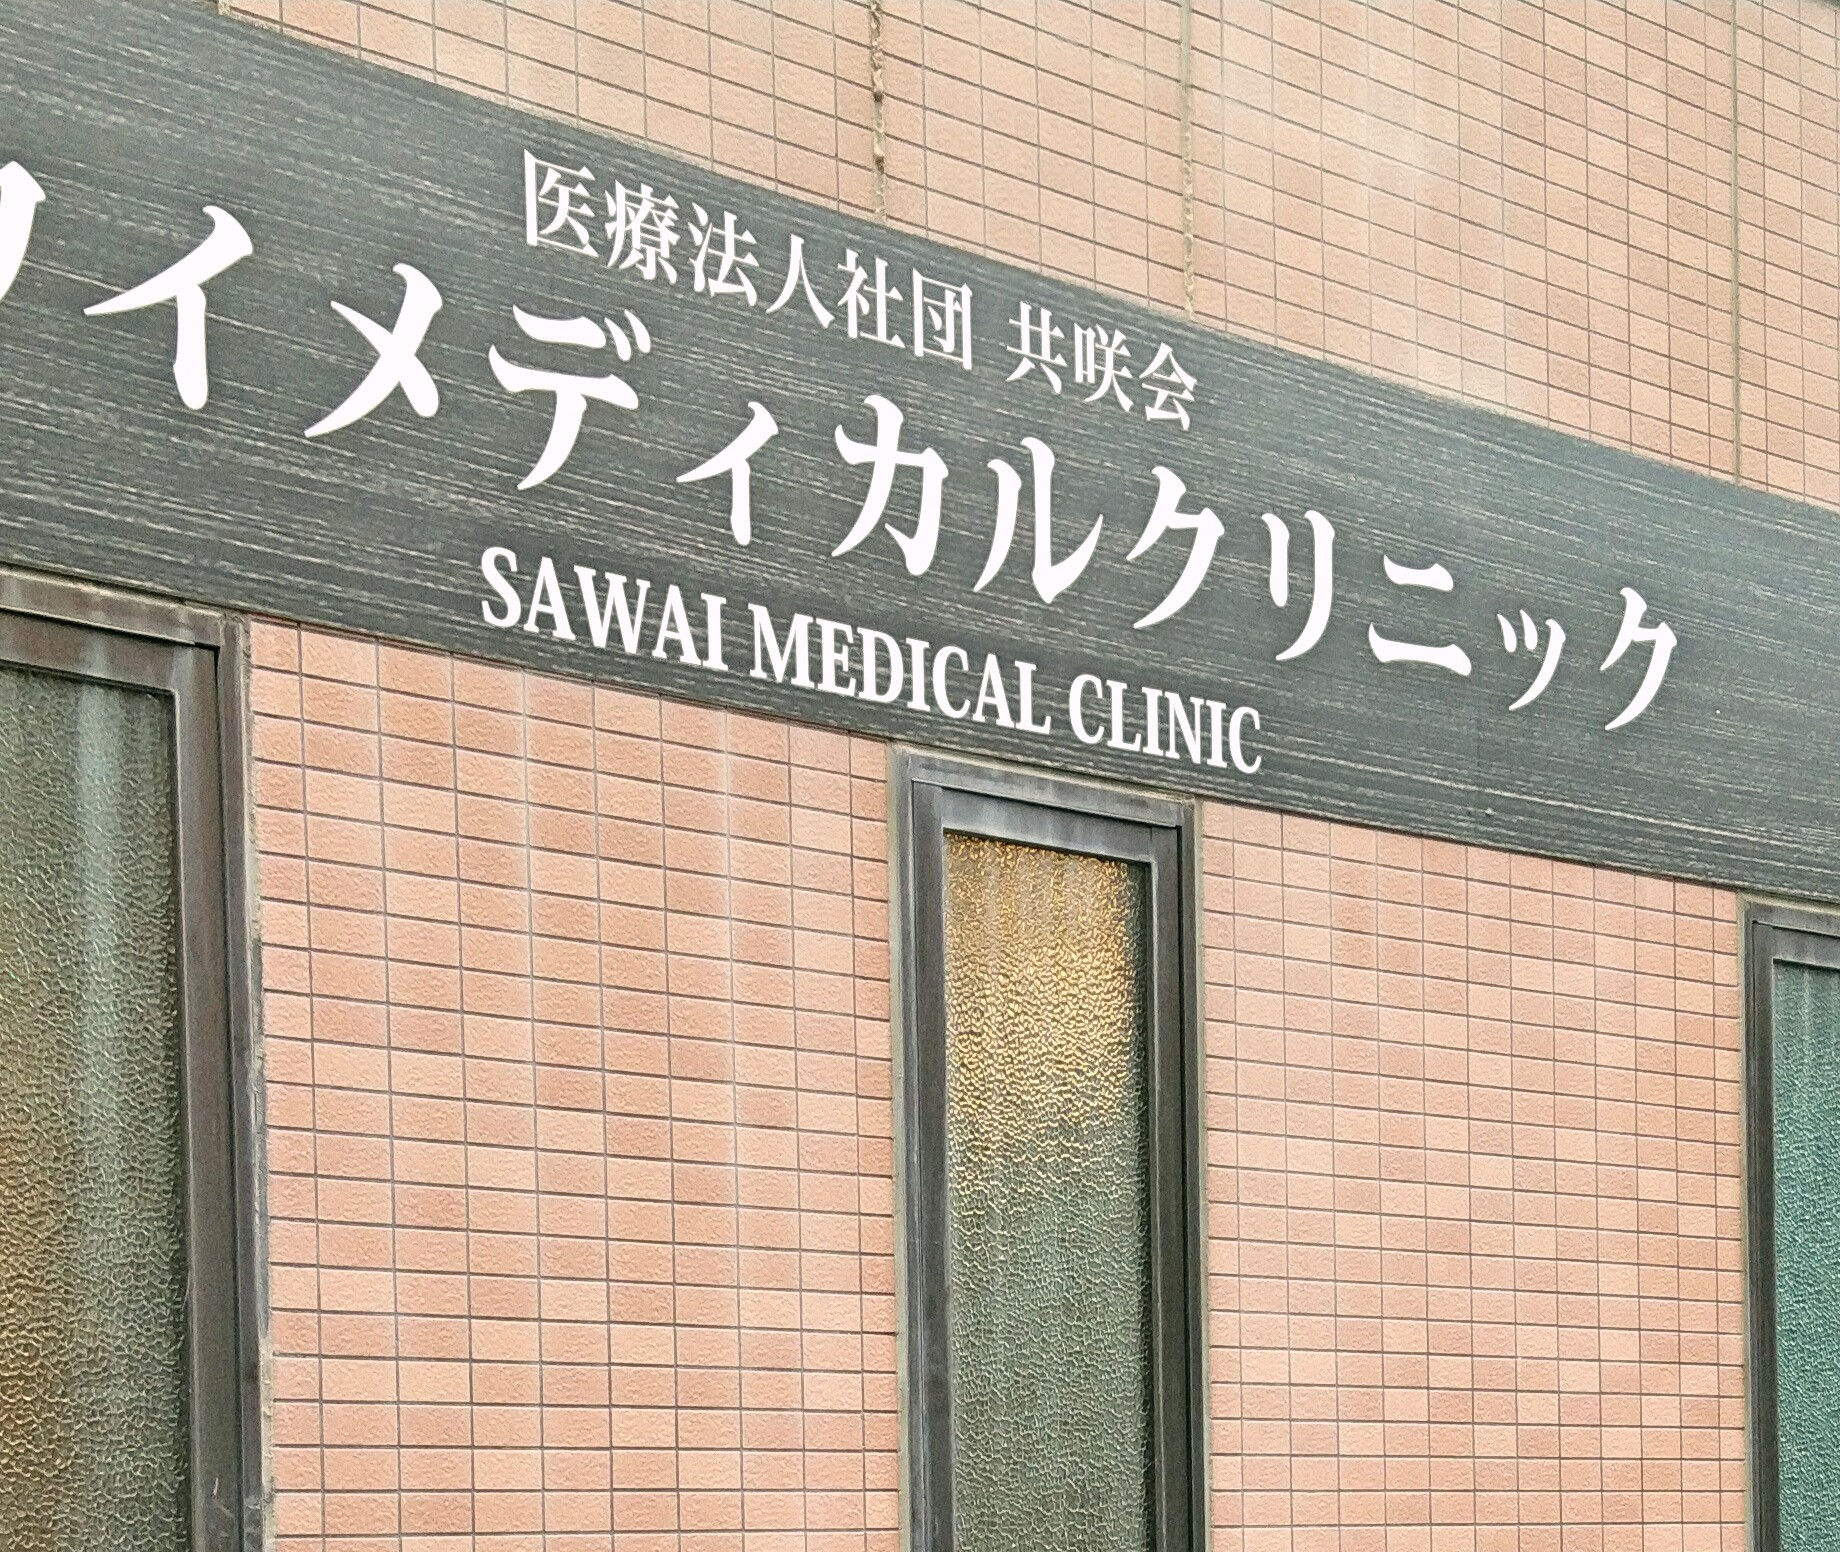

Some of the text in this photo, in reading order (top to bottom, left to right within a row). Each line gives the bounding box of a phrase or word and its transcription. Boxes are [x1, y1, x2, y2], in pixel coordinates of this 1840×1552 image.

[523, 148, 1198, 431] 医療法人社団 共咲会
[480, 546, 1264, 775] SAWAI MEDICAL CLINIC
